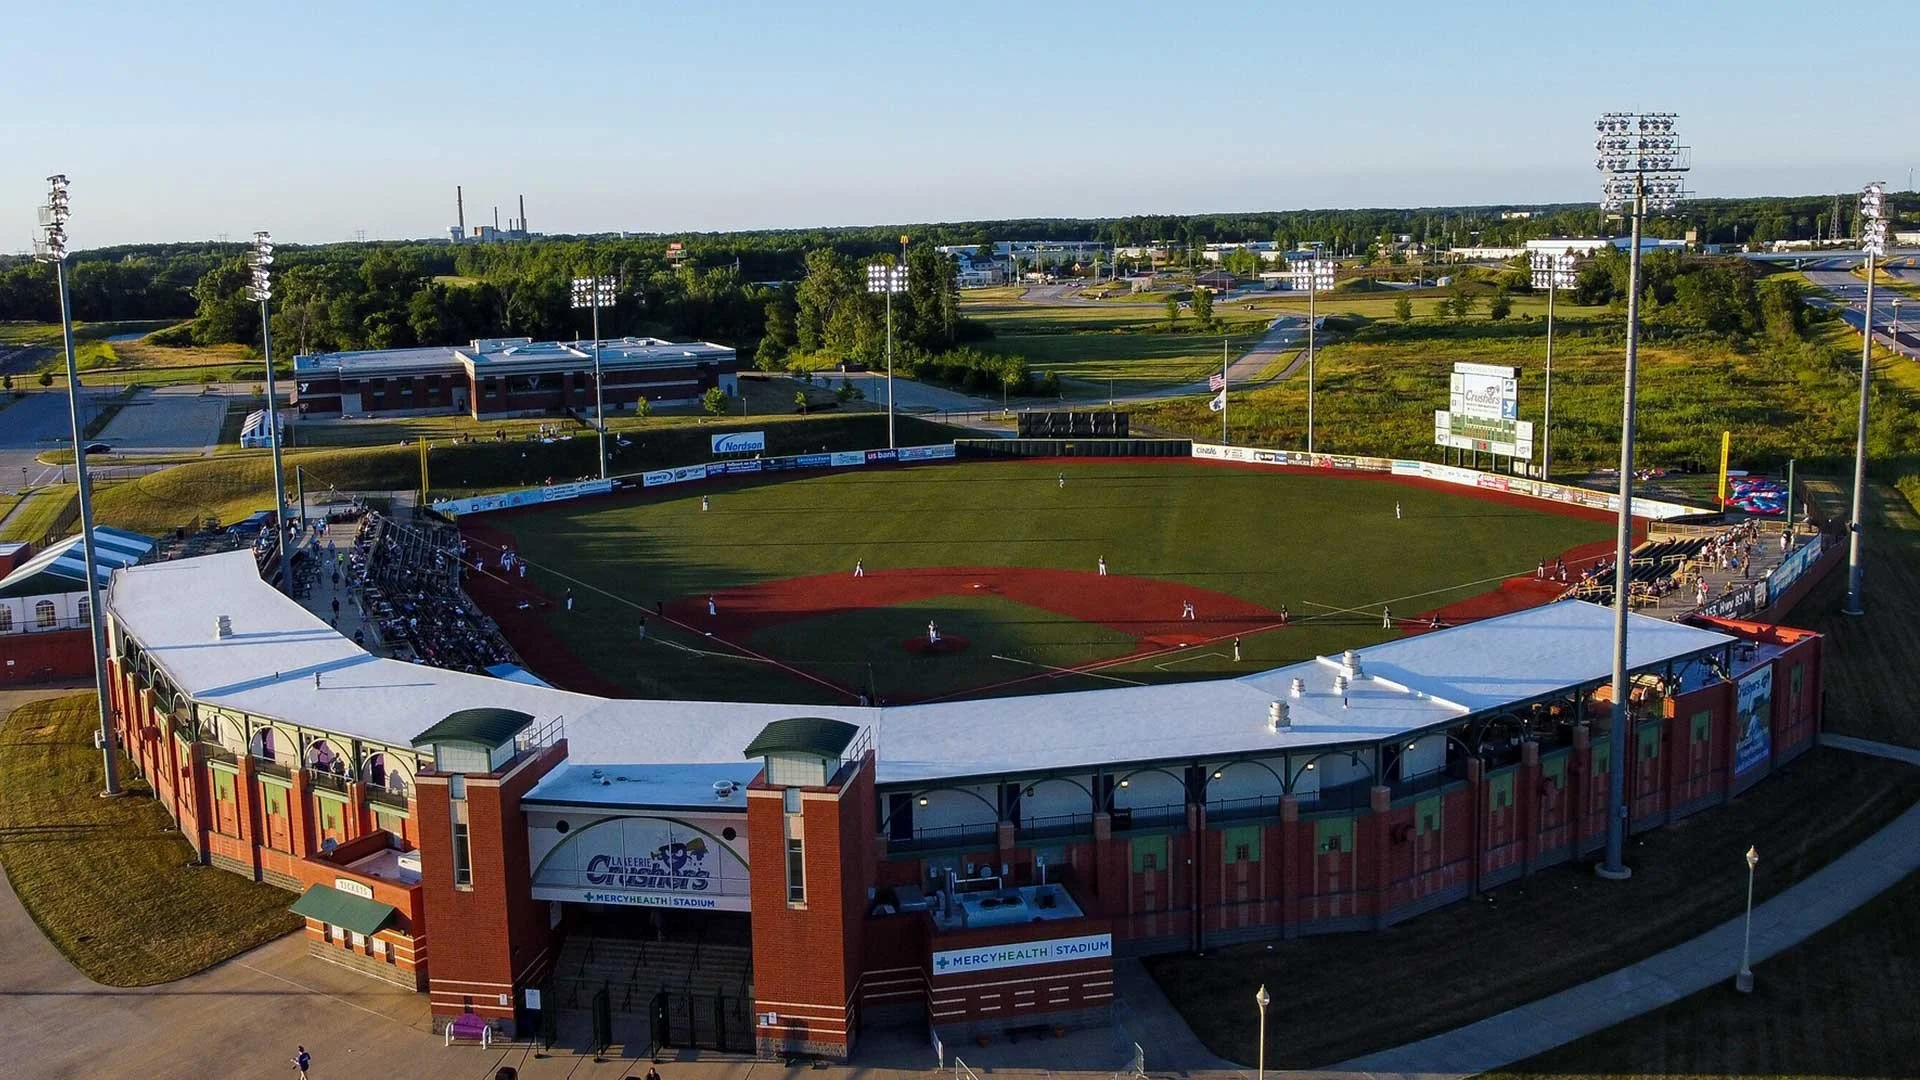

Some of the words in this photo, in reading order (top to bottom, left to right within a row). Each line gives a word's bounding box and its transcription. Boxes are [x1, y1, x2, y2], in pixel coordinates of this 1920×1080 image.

[1466, 389, 1501, 404] Crushers
[725, 440, 763, 451] Nordson
[877, 450, 896, 459] bank
[1719, 600, 1734, 614] Hwy
[611, 856, 633, 866] LAKE
[633, 857, 652, 868] ERIE
[586, 854, 710, 891] Crushers
[340, 881, 368, 896] TICKETS
[596, 893, 668, 905] MERCYHEALTH
[673, 898, 715, 908] STADIUM
[953, 947, 1048, 967] MERCYHEALTH
[1056, 941, 1109, 956] STADIUM
